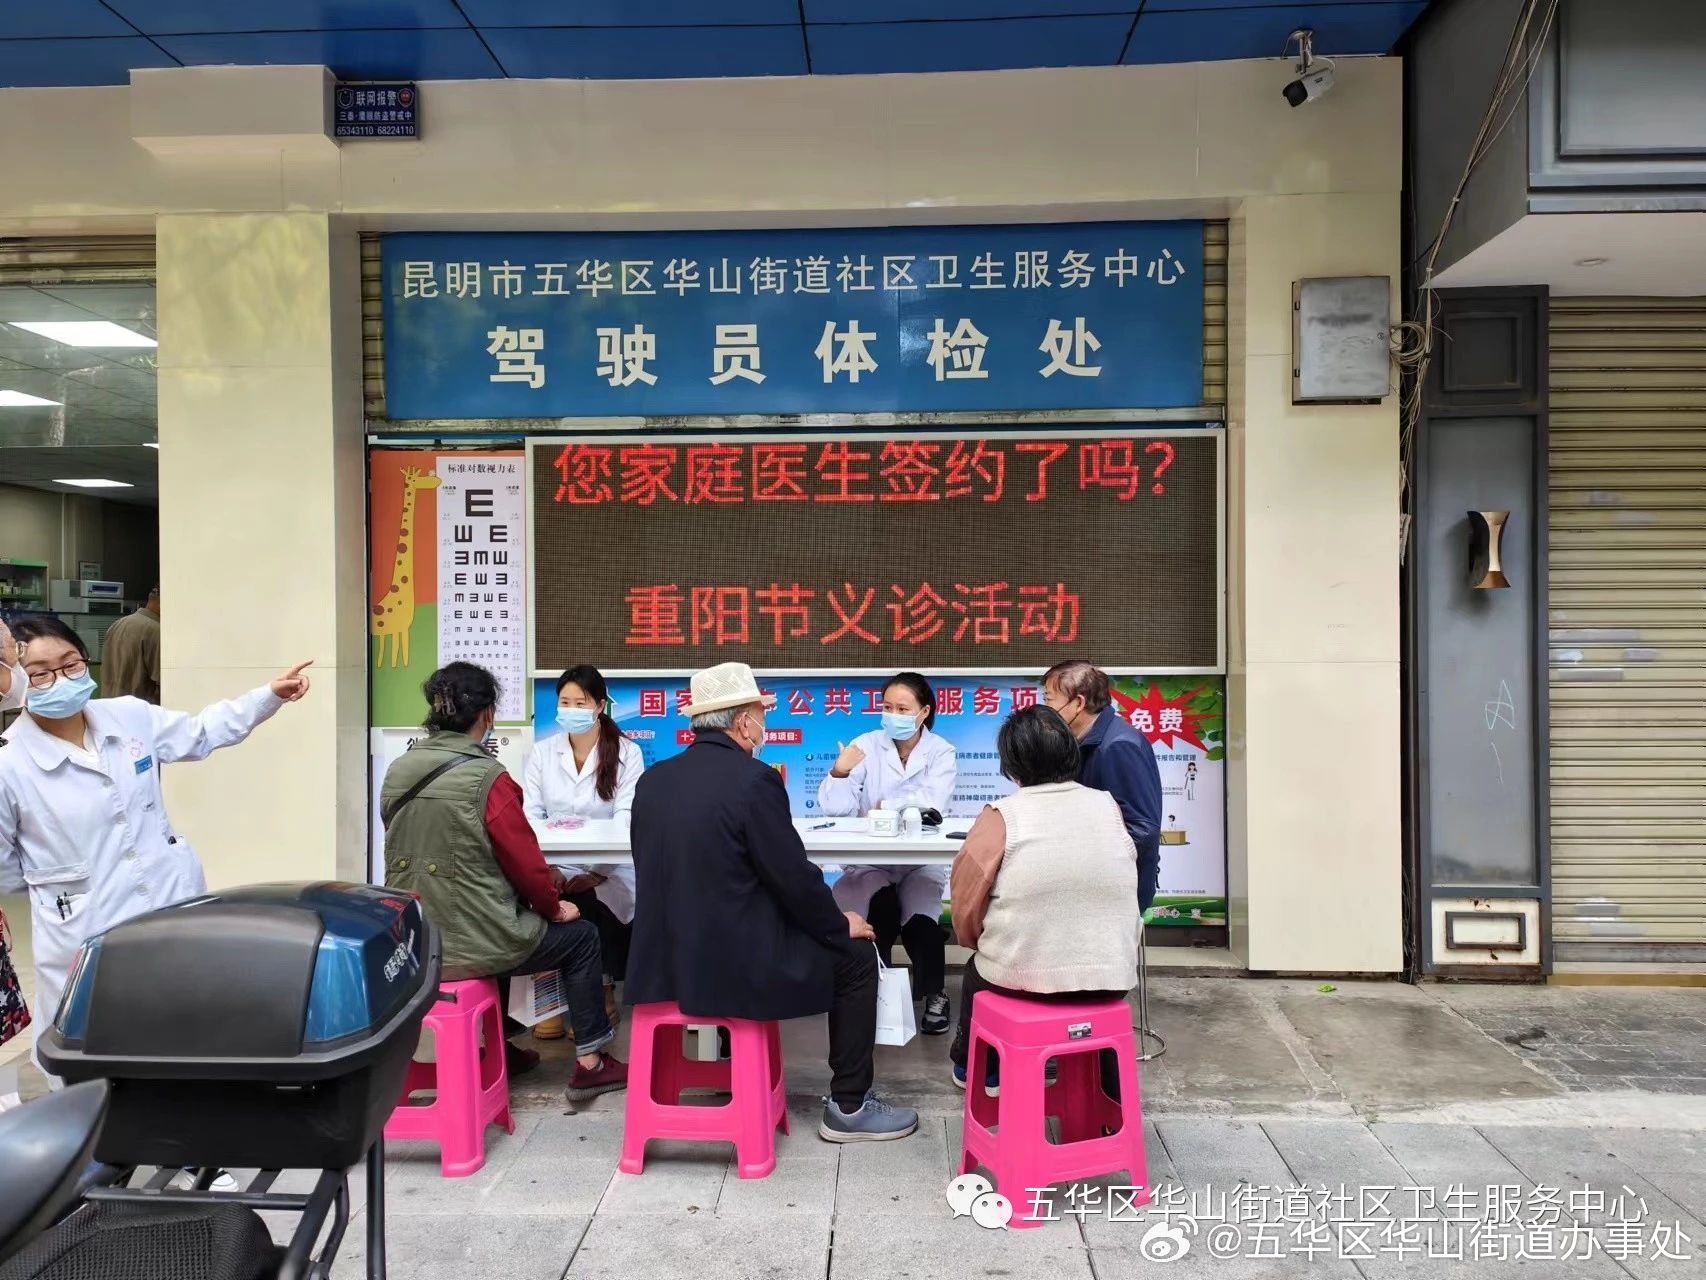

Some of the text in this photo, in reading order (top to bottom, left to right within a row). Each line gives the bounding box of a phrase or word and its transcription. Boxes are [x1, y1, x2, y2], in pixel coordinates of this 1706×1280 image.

[356, 91, 397, 106] 联网报警
[377, 125, 414, 135] 68224110
[402, 247, 1186, 299] 昆明市五华区华山街道社区卫生服务中心
[486, 316, 1102, 389] 驾驶员体检处
[448, 463, 516, 474] 标准对数视力表
[553, 438, 1177, 506] 您家庭医生签约了吗?
[624, 581, 1081, 646] 重阳节义诊活动
[1129, 707, 1183, 733] 免费
